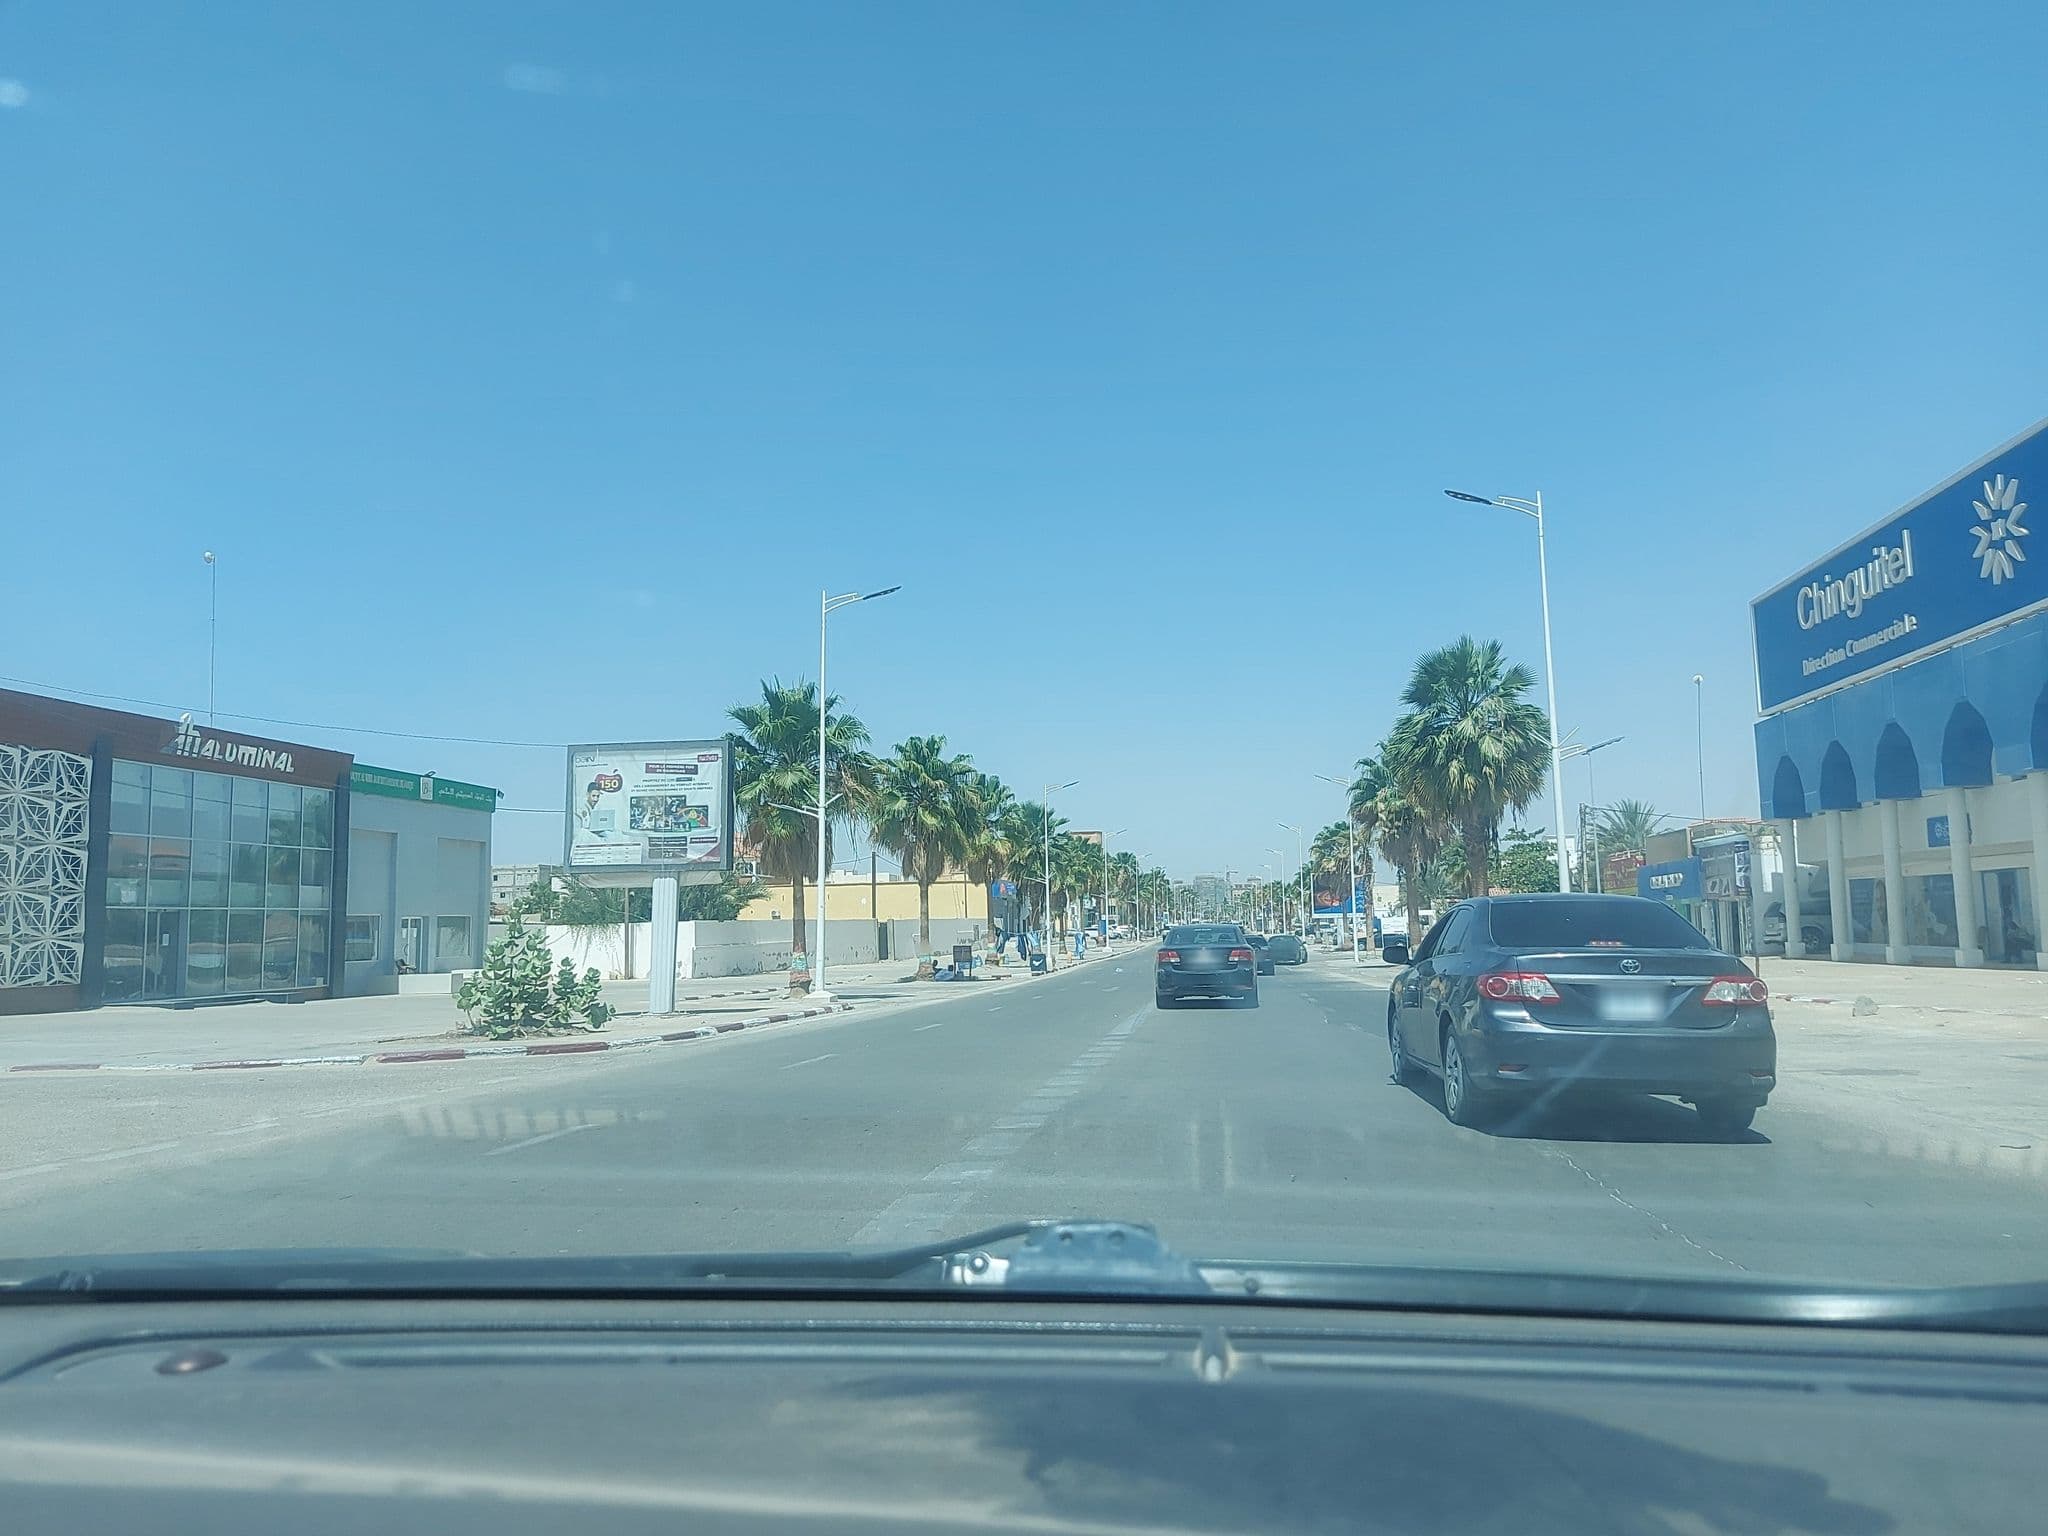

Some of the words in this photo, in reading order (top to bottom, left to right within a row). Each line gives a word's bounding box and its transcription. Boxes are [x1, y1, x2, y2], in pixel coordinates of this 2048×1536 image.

[1796, 528, 1914, 630] Chinguitel
[1802, 647, 1846, 676] Direction
[1845, 612, 1918, 659] Commerciale
[200, 738, 295, 773] ALUMINAL
[599, 779, 619, 789] 150
